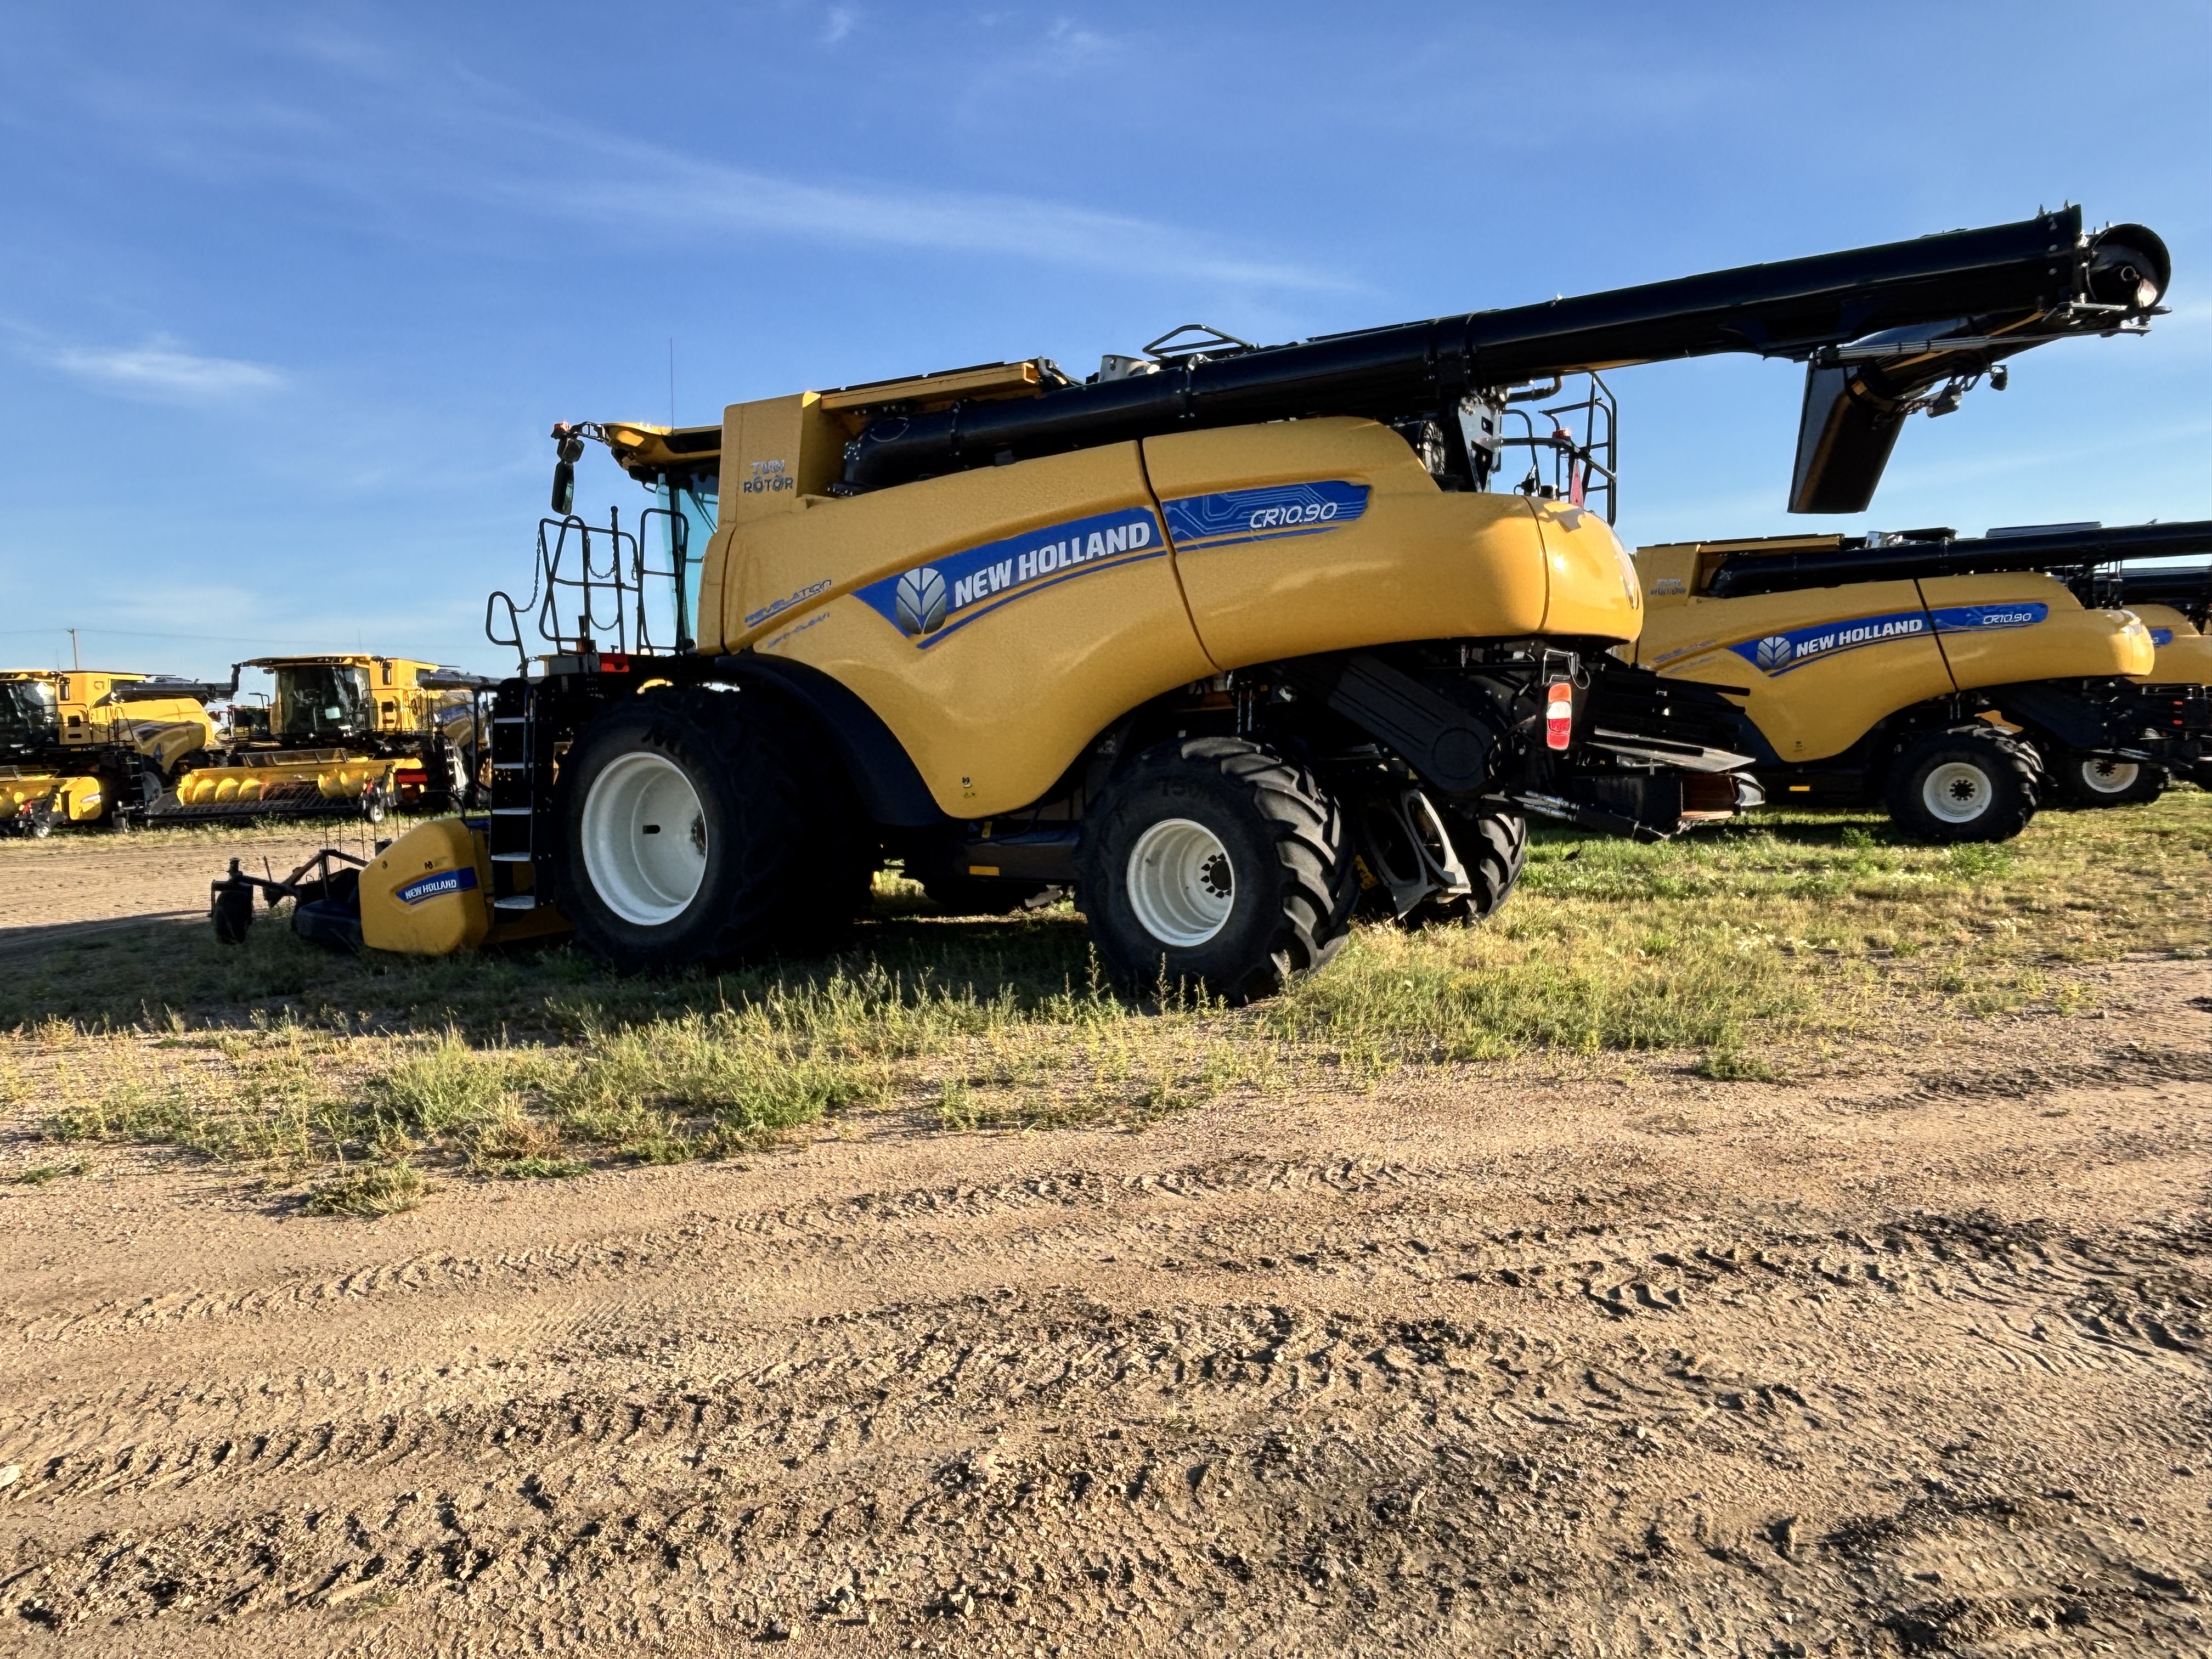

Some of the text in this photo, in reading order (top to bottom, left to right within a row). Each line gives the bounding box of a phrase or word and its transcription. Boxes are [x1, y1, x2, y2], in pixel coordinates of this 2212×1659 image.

[743, 476, 794, 493] ROTOR
[1250, 502, 1338, 528] CR10.90
[955, 522, 1150, 608] NEW HOLLAND
[1796, 619, 1923, 657] NEW HOLLAND
[405, 879, 456, 899] NEW HOLLAND
